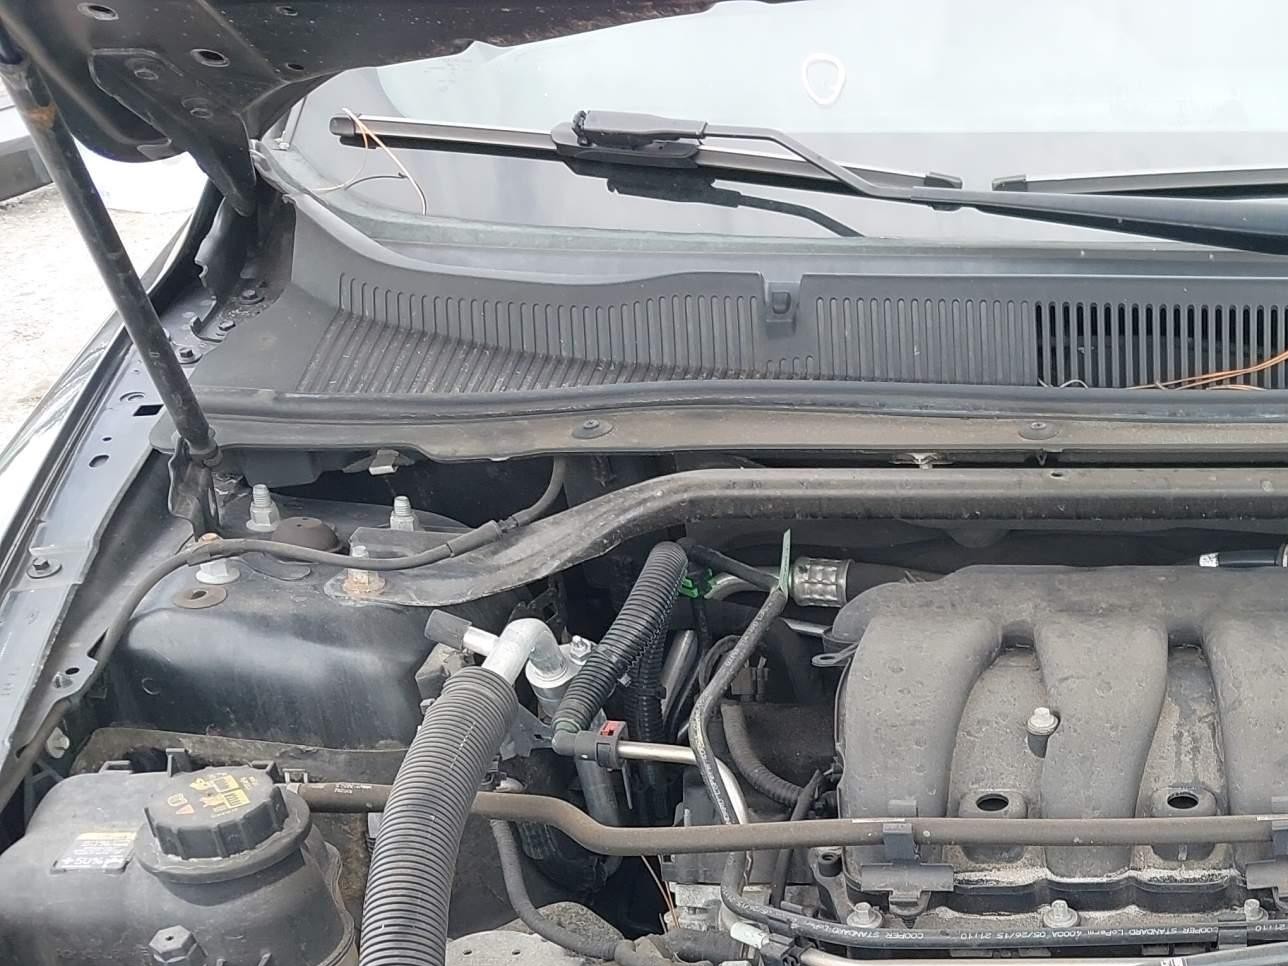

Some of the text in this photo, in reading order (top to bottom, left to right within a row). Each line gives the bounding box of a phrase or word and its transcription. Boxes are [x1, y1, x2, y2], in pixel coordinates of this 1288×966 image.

[831, 926, 880, 939] STANDARD
[885, 931, 925, 940] COOPER
[1129, 927, 1178, 936] STANDARD
